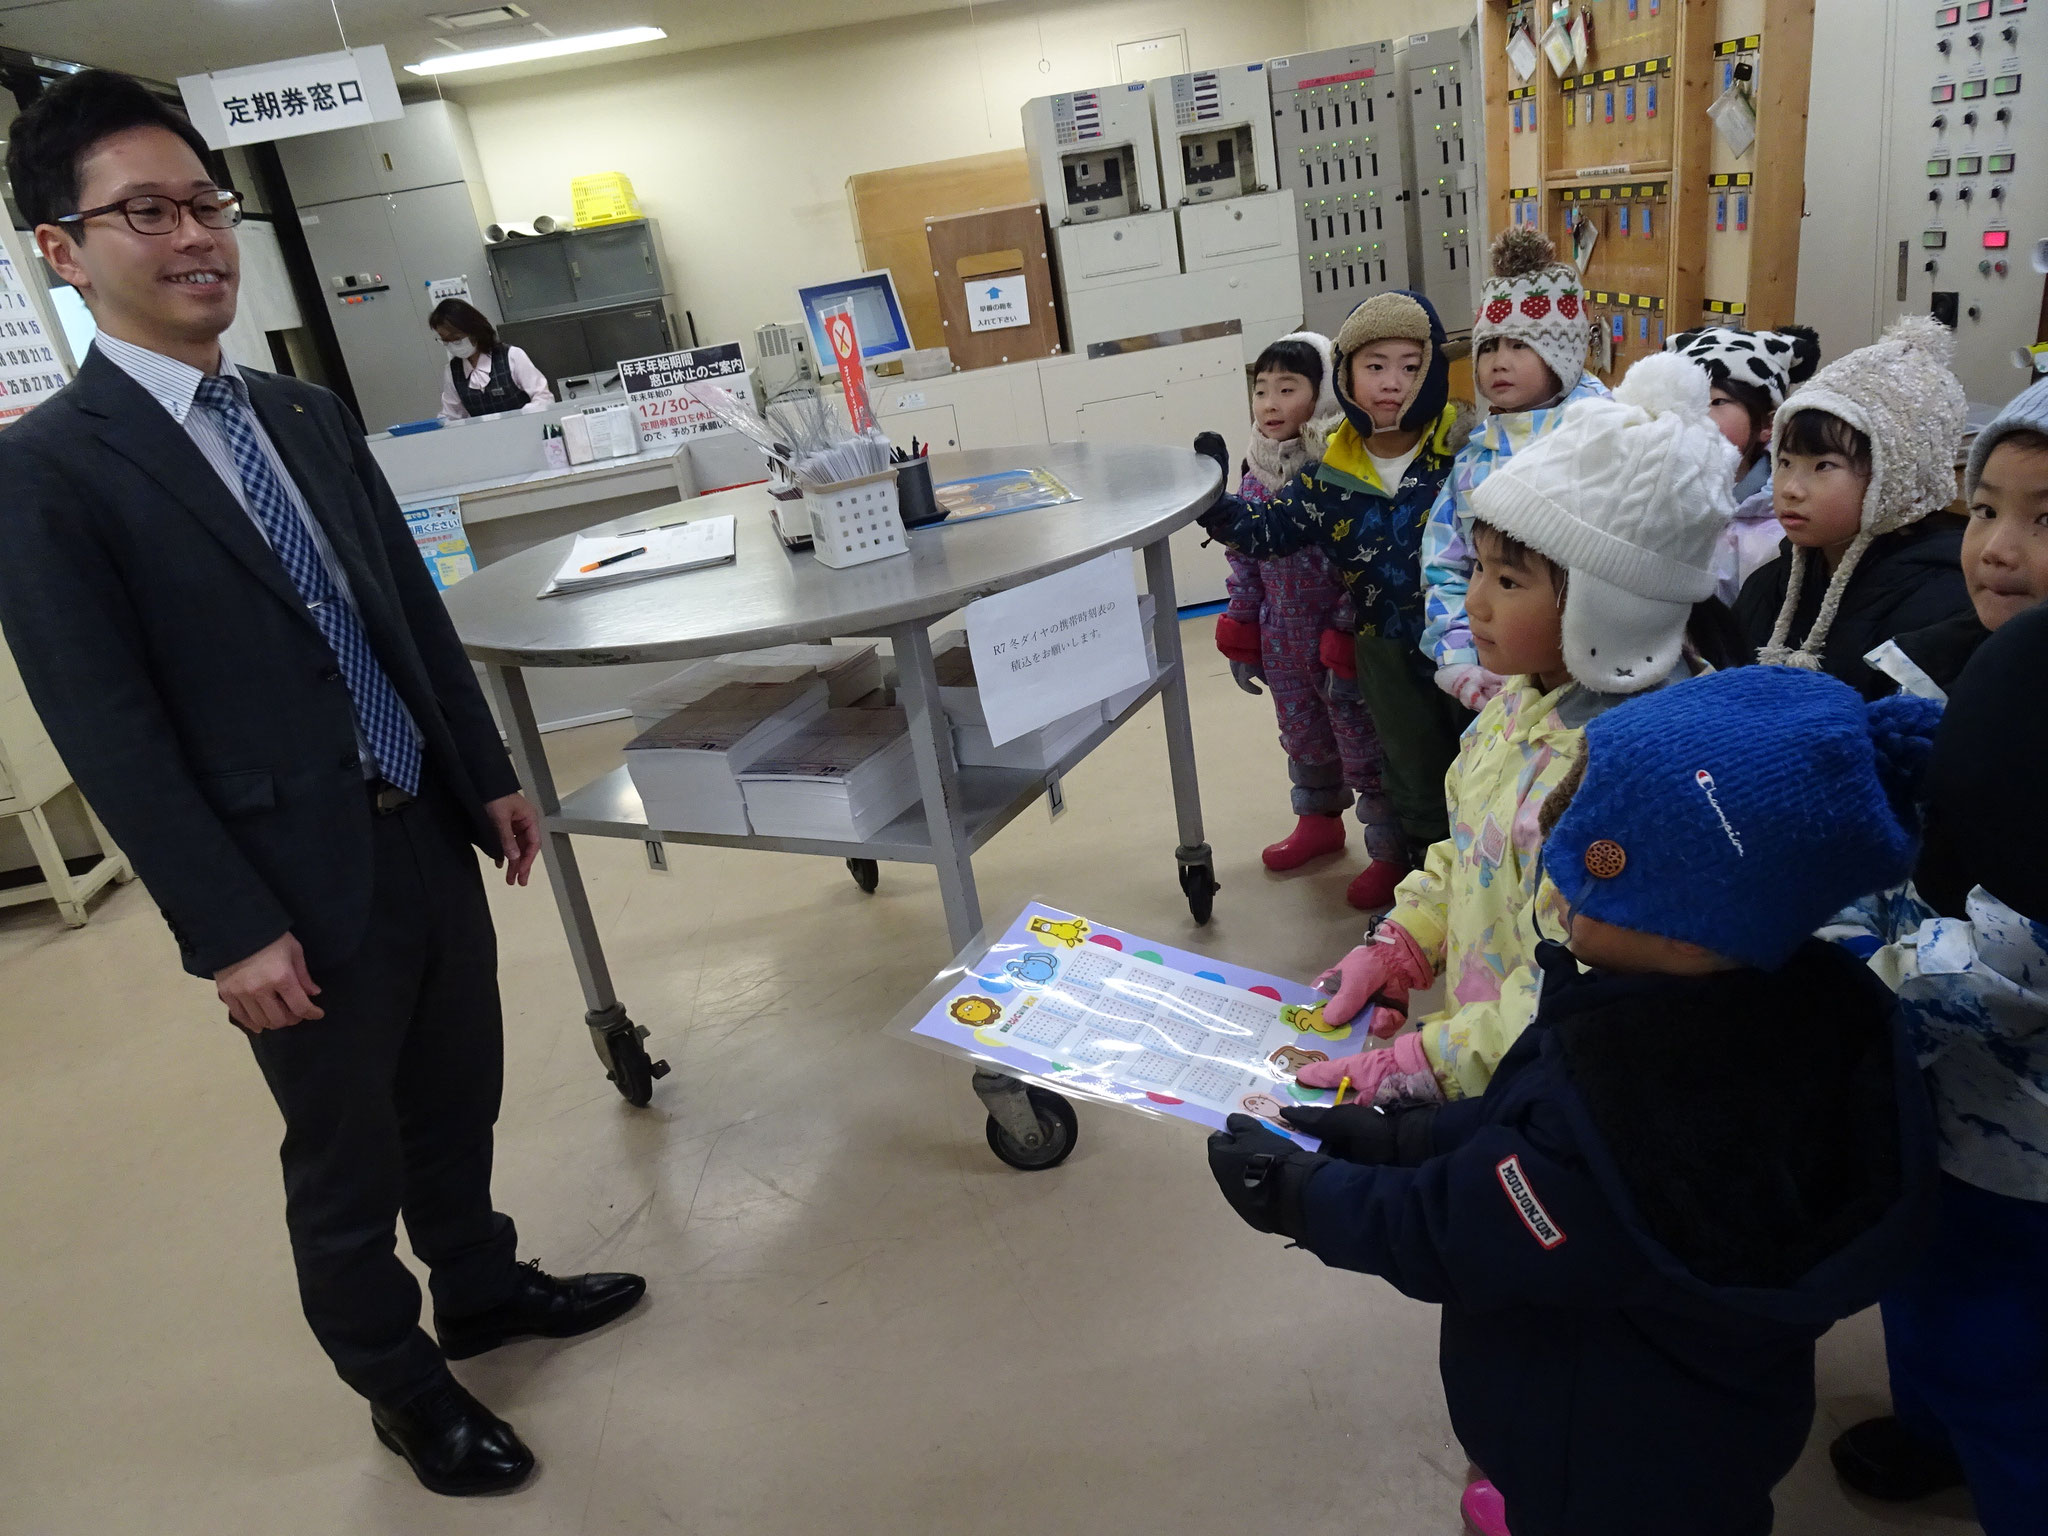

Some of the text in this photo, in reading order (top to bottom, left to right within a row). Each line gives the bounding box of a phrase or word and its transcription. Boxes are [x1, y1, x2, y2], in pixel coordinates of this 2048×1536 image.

[223, 80, 363, 126] 定期券窓口
[5, 266, 13, 280] 1
[4, 293, 26, 308] 7 8
[5, 322, 17, 336] 13
[17, 321, 29, 335] 14
[28, 320, 41, 334] 15
[977, 315, 1018, 327] 入れて下さい
[6, 350, 19, 365] 19
[17, 349, 30, 364] 20
[29, 348, 42, 362] 21
[40, 346, 53, 361] 22
[622, 353, 694, 377] 年末年始期間
[7, 380, 20, 394] 25
[19, 378, 31, 393] 26
[31, 376, 42, 391] 27
[42, 375, 54, 389] 28
[53, 373, 65, 387] 29
[649, 358, 744, 388] 窓口休止のご案内
[630, 388, 673, 403] 年末年始の
[640, 410, 714, 432] 定期券窓口を休止
[1010, 628, 1102, 673] 積込をお願いします。
[1696, 769, 1744, 857] Champion
[1502, 1163, 1557, 1241] MOUJONJON
